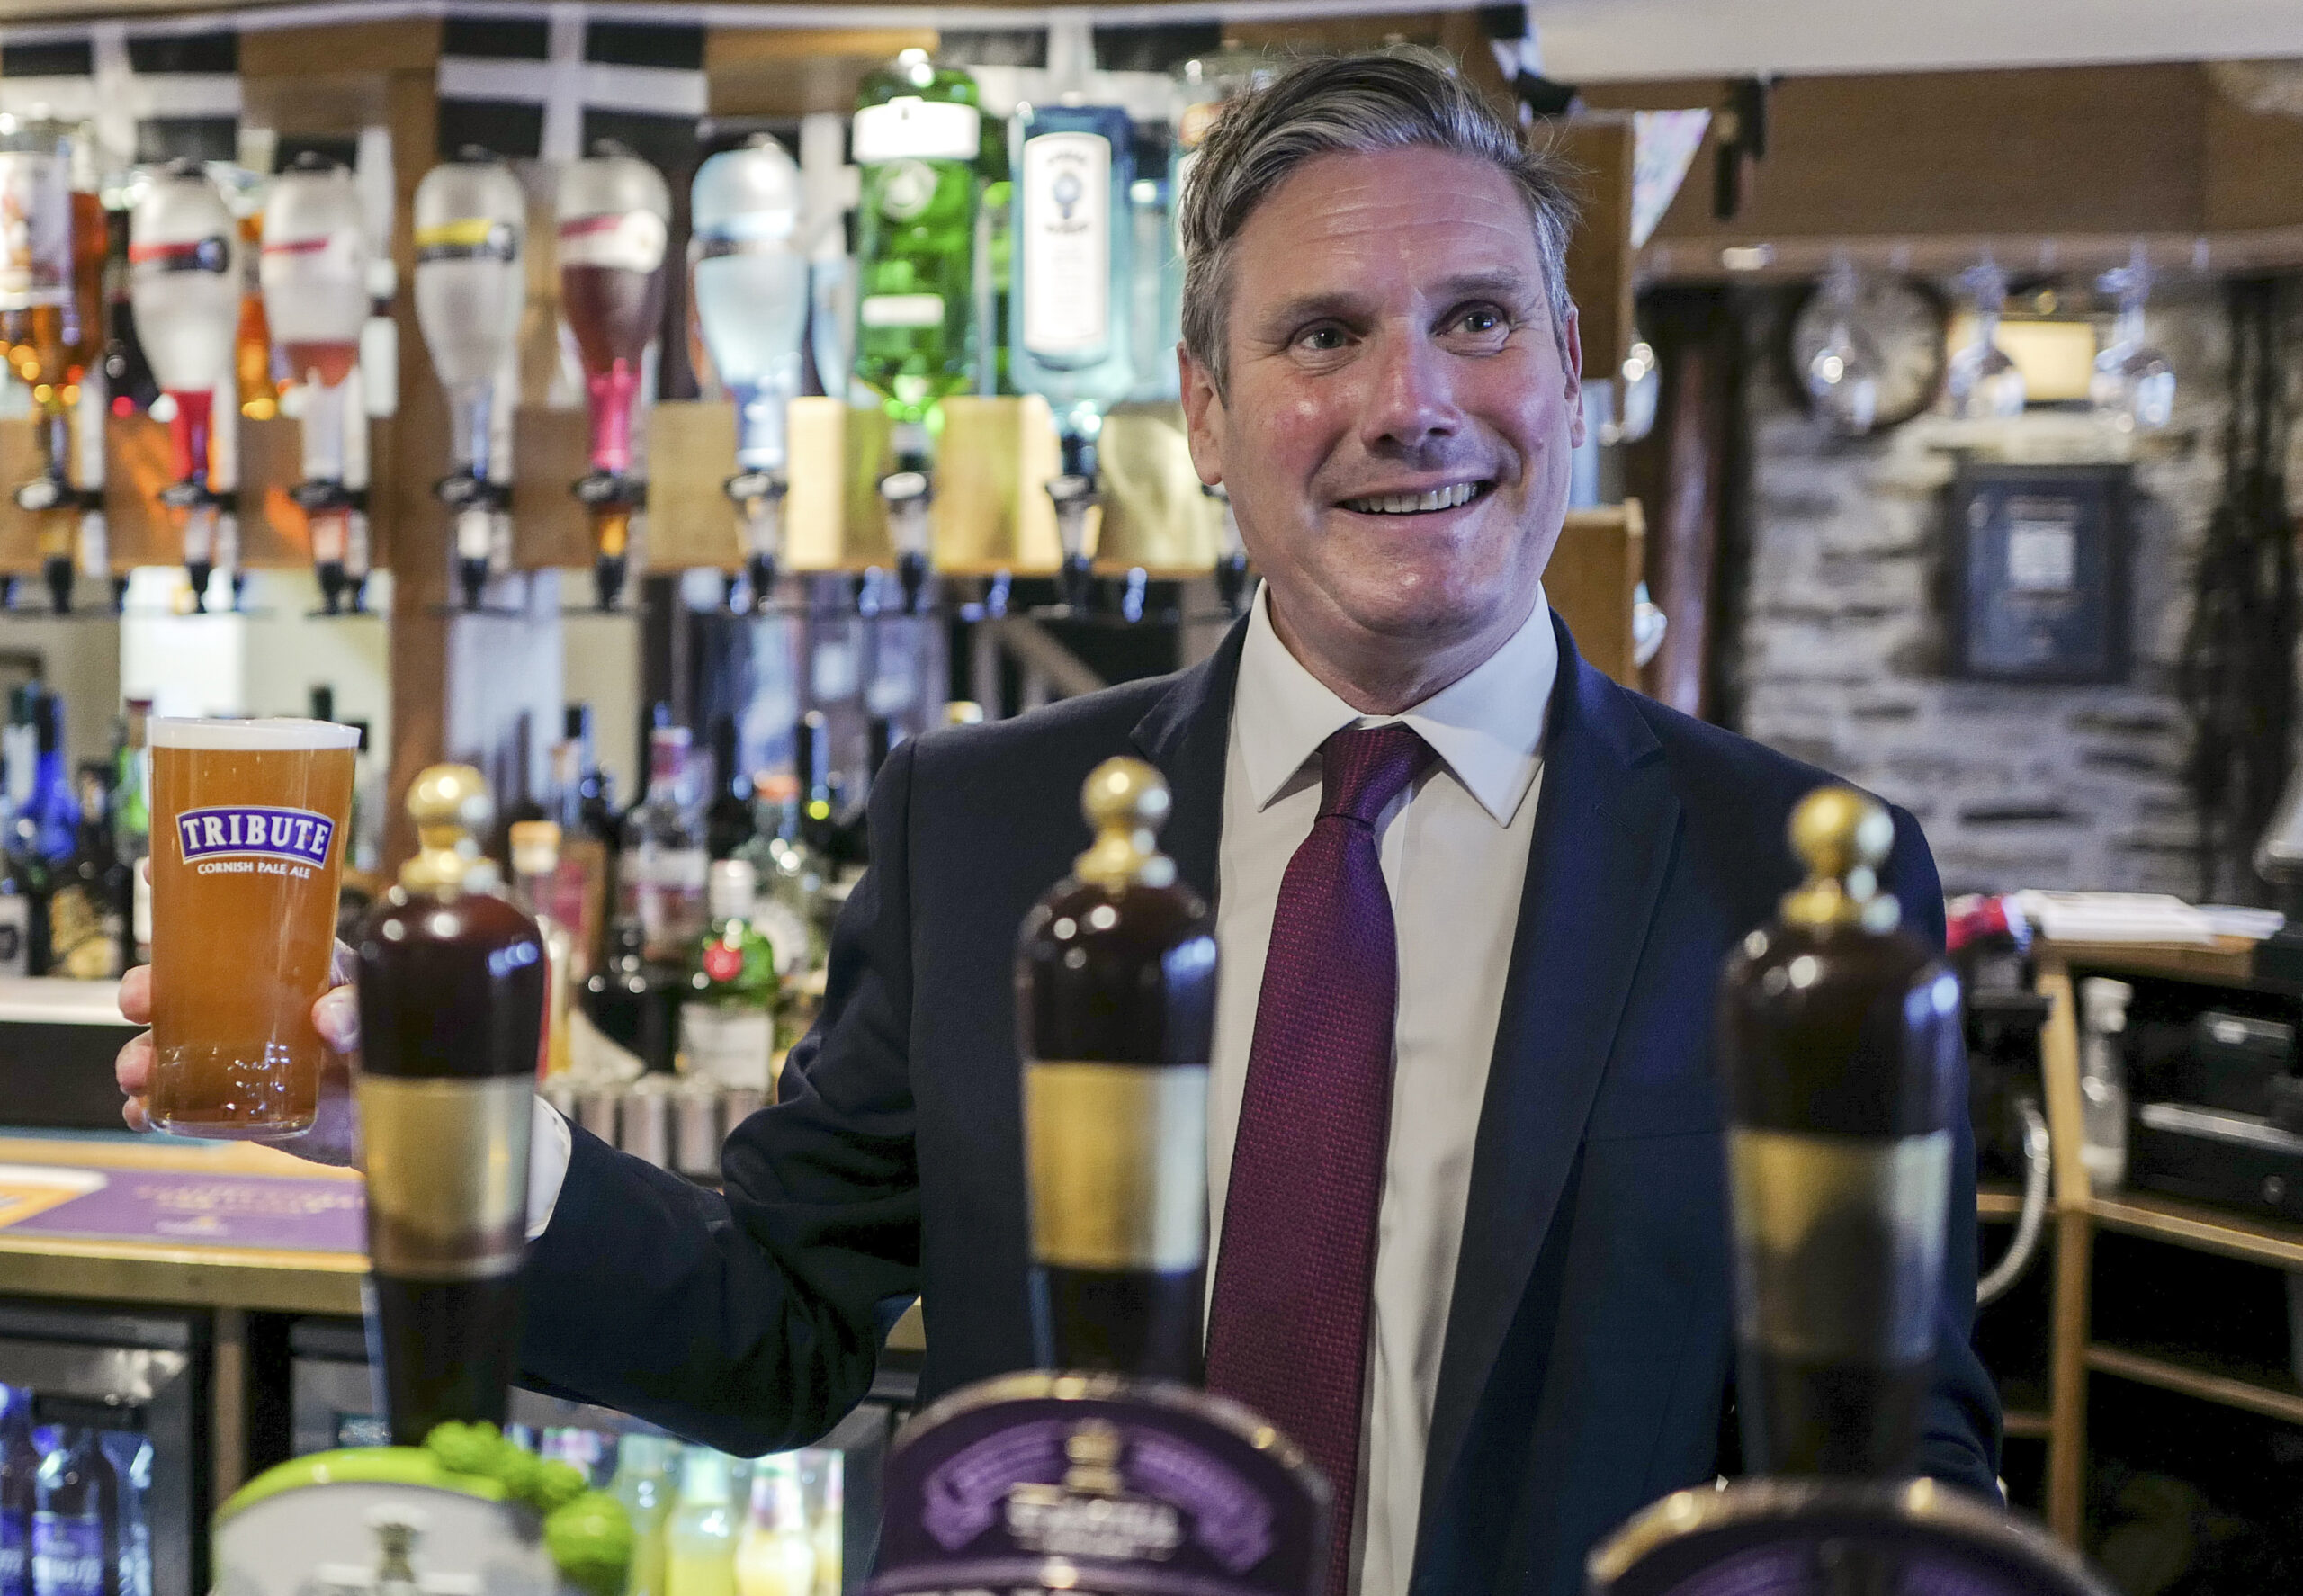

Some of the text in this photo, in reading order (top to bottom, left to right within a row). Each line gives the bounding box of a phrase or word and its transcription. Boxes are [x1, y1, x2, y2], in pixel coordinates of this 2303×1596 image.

[182, 814, 329, 855] TRIBUTE
[197, 861, 311, 879] CORNISH PALE ALE
